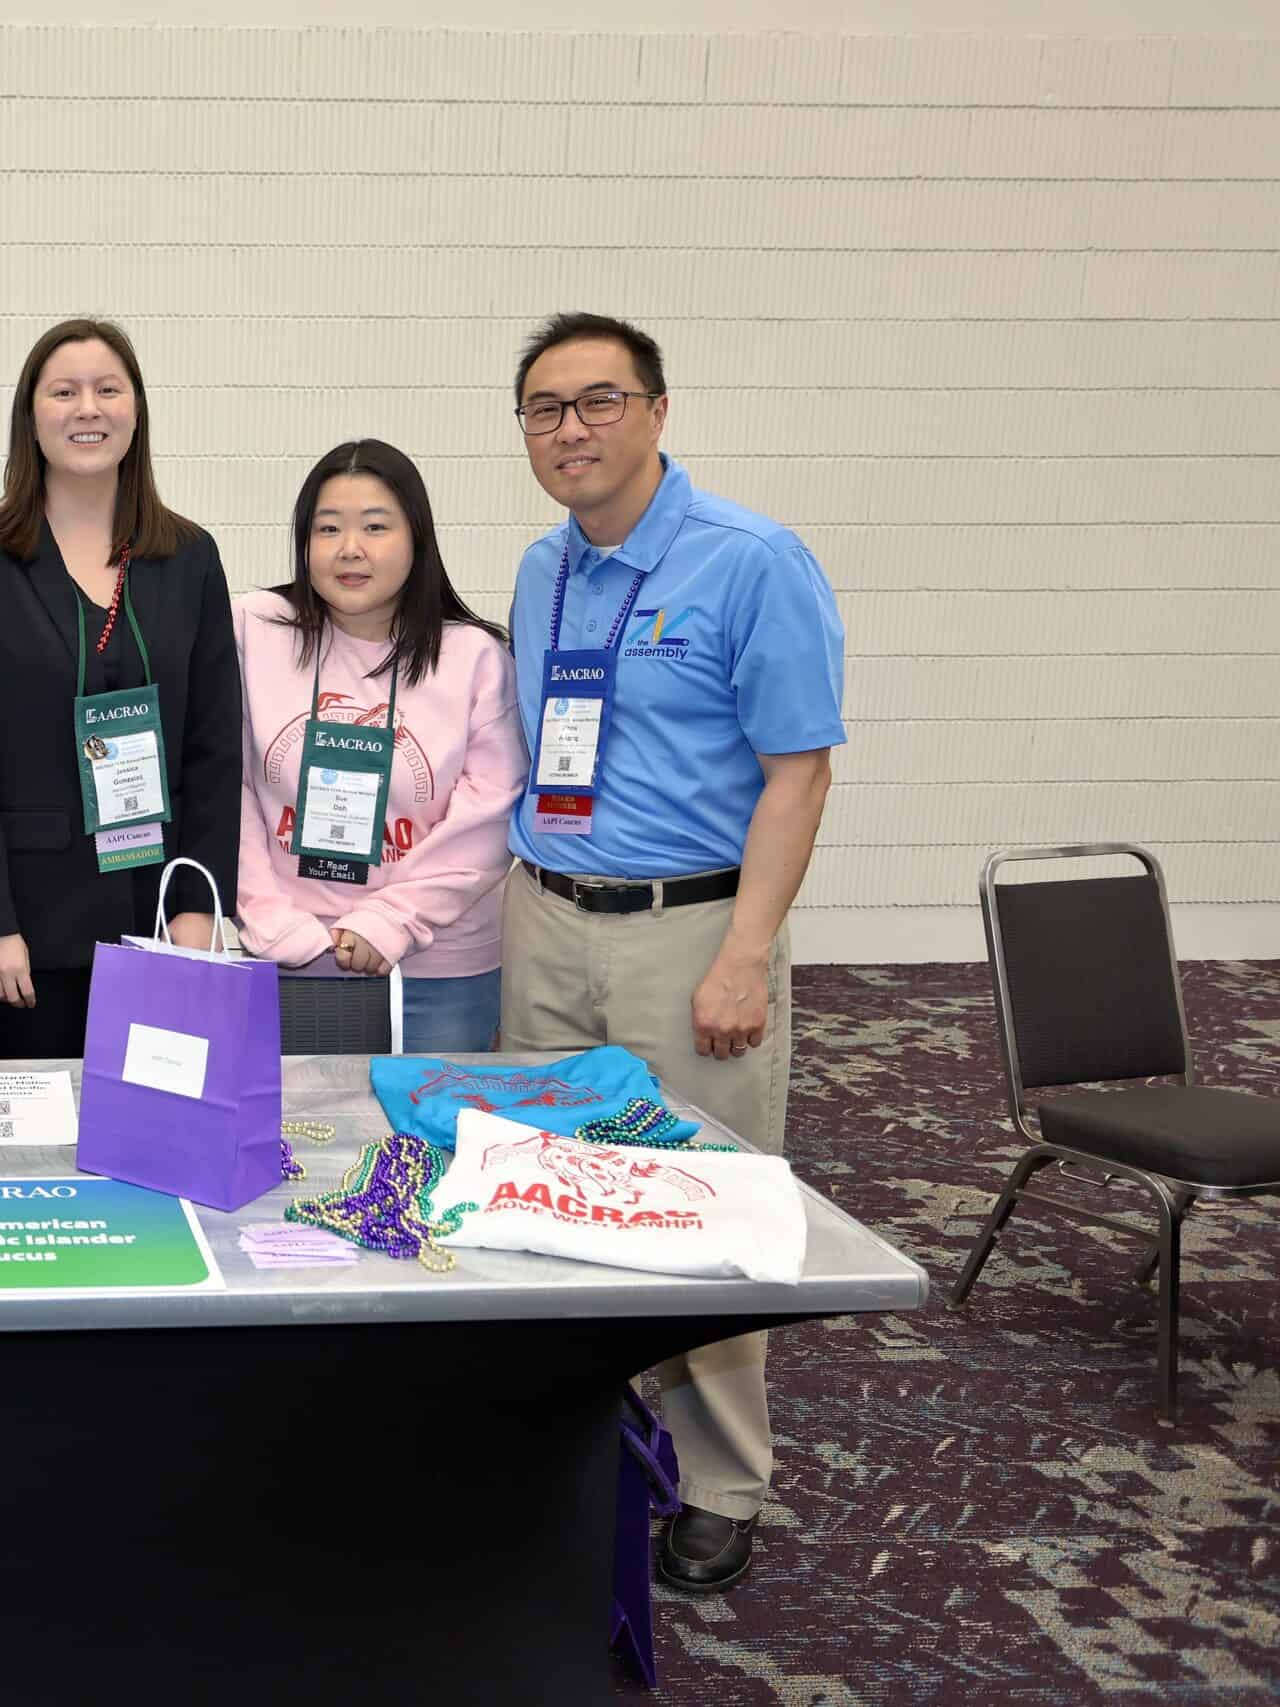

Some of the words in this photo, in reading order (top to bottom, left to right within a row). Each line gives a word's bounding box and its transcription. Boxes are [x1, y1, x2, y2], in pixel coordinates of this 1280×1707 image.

[624, 647, 688, 660] assembly
[559, 667, 604, 681] AACRAO
[98, 703, 149, 722] AACRAO
[326, 736, 383, 753] AACRAO
[326, 861, 349, 871] Read
[308, 867, 329, 877] Your
[330, 870, 356, 880] Email
[484, 1200, 545, 1214] MOVE
[26, 1231, 137, 1246] Islander
